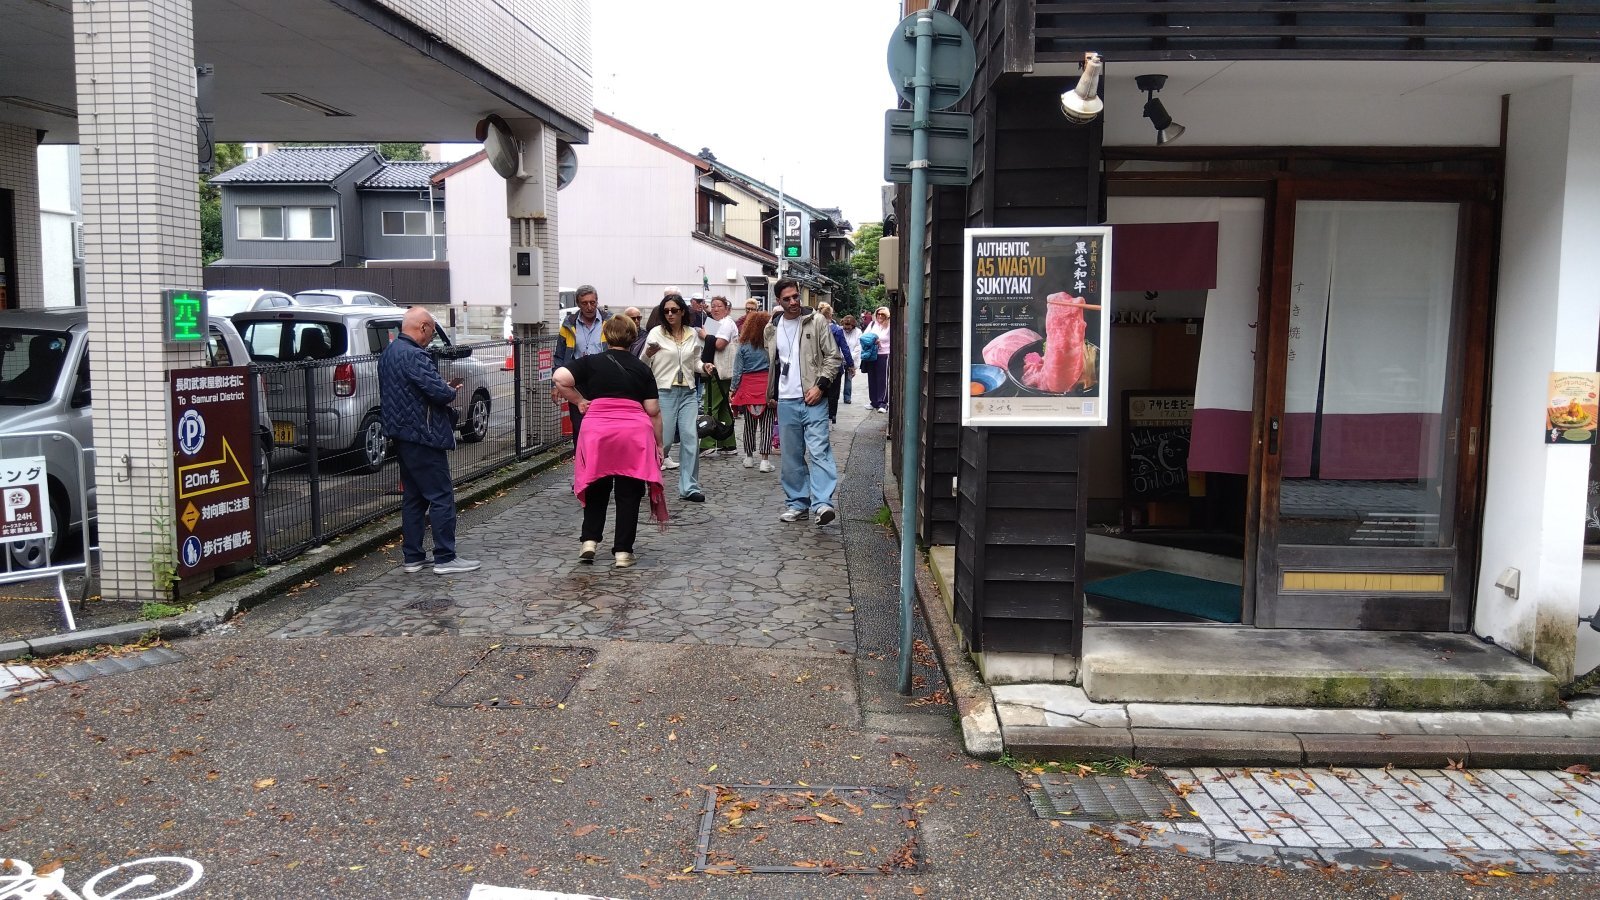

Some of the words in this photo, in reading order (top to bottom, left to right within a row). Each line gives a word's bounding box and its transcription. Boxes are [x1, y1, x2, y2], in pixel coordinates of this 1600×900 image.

[976, 241, 1030, 257] AUTHENTIC
[976, 257, 995, 277] A5
[997, 256, 1046, 277] WAGYU
[1073, 241, 1088, 294] 黒毛和牛
[976, 277, 1031, 295] SUKIYAKI
[173, 293, 201, 338] 空
[176, 375, 244, 391] 長町武家屋敷は右に
[177, 396, 187, 405] To
[191, 393, 219, 404] Samurai
[219, 391, 245, 402] District
[186, 419, 199, 447] P
[0, 466, 42, 483] ング
[185, 473, 209, 489] 20m
[210, 469, 220, 485] 先
[3, 487, 31, 522] P
[202, 496, 250, 520] 対向車に注意
[16, 512, 32, 521] 24H
[203, 530, 252, 557] 歩行者優先
